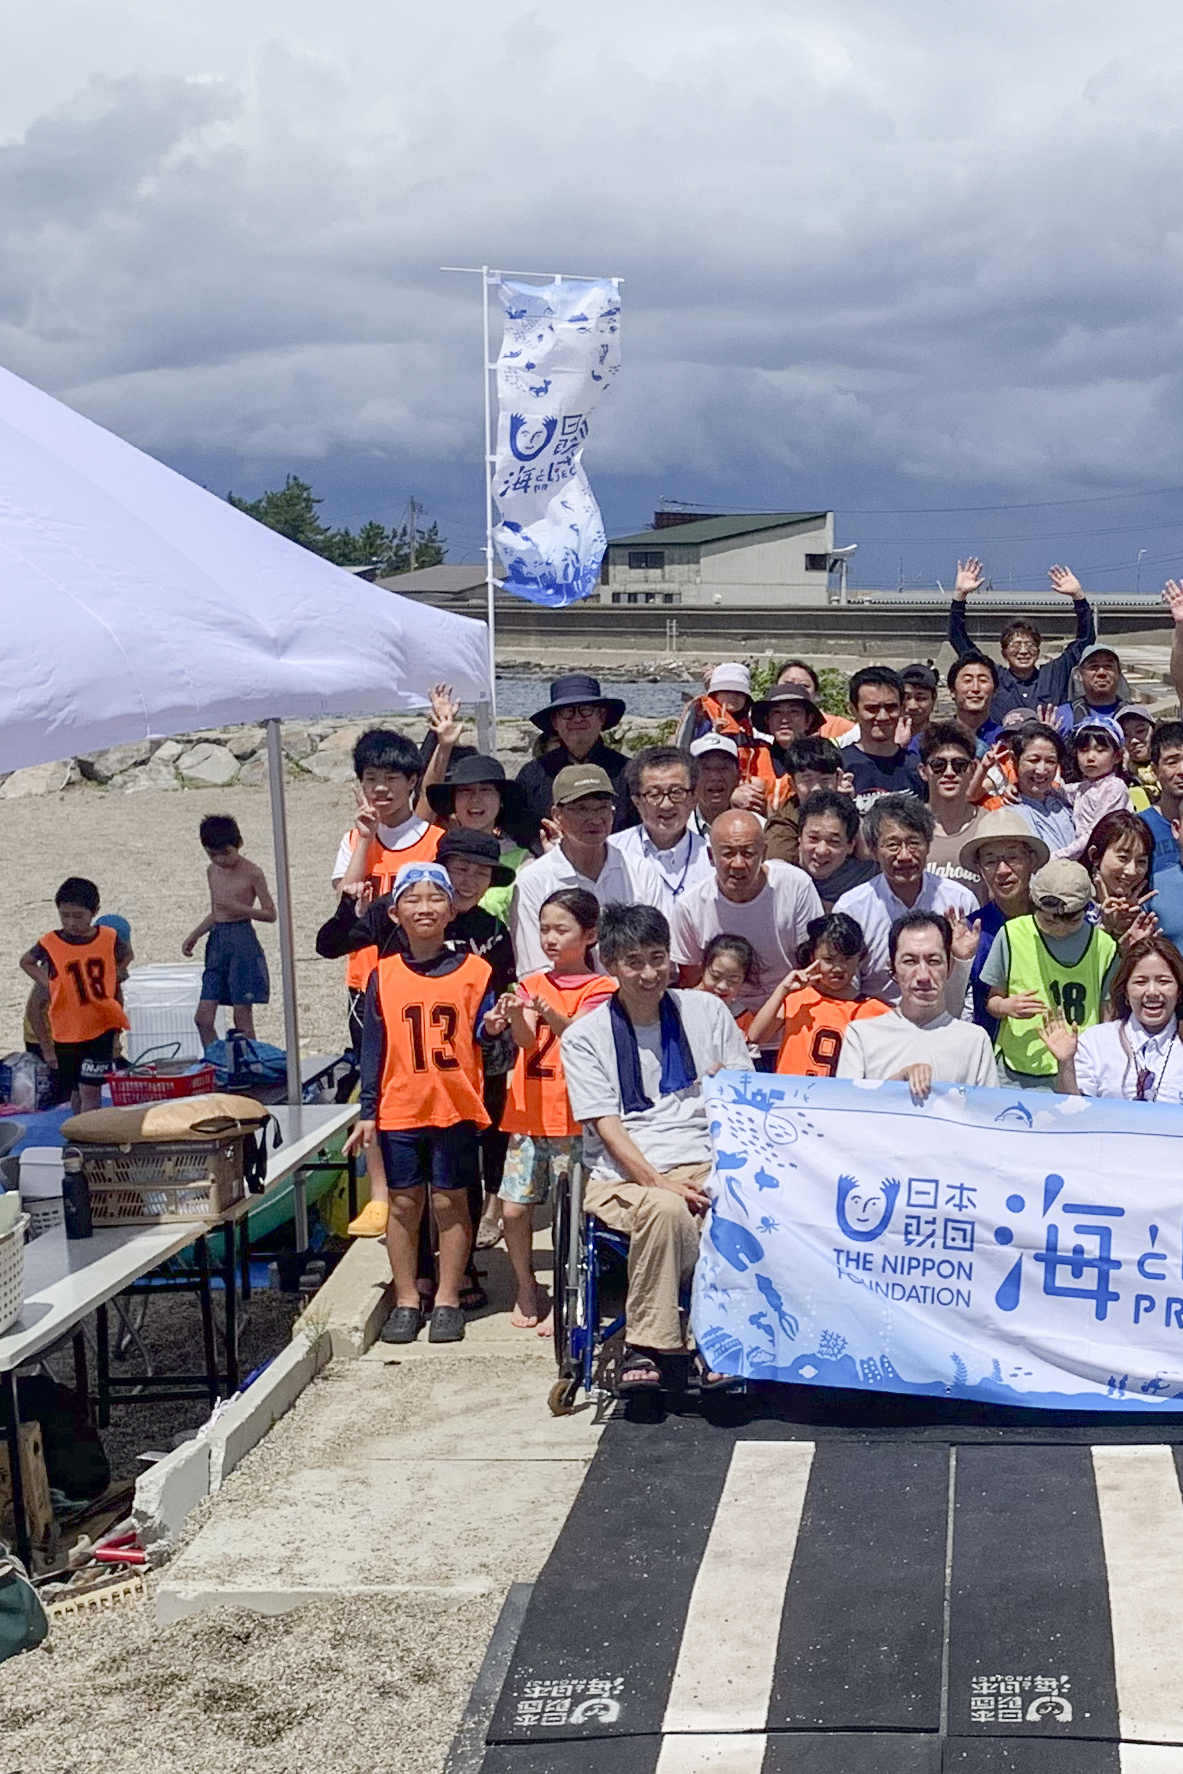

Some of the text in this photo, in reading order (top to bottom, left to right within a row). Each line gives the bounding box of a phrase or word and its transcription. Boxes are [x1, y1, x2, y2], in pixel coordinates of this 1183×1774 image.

[65, 956, 109, 1006] 18
[1049, 979, 1087, 1027] 18
[402, 1002, 461, 1074] 13
[905, 1177, 978, 1212] 日本
[904, 1214, 976, 1252] 財団
[833, 1248, 973, 1281] THE NIPPON
